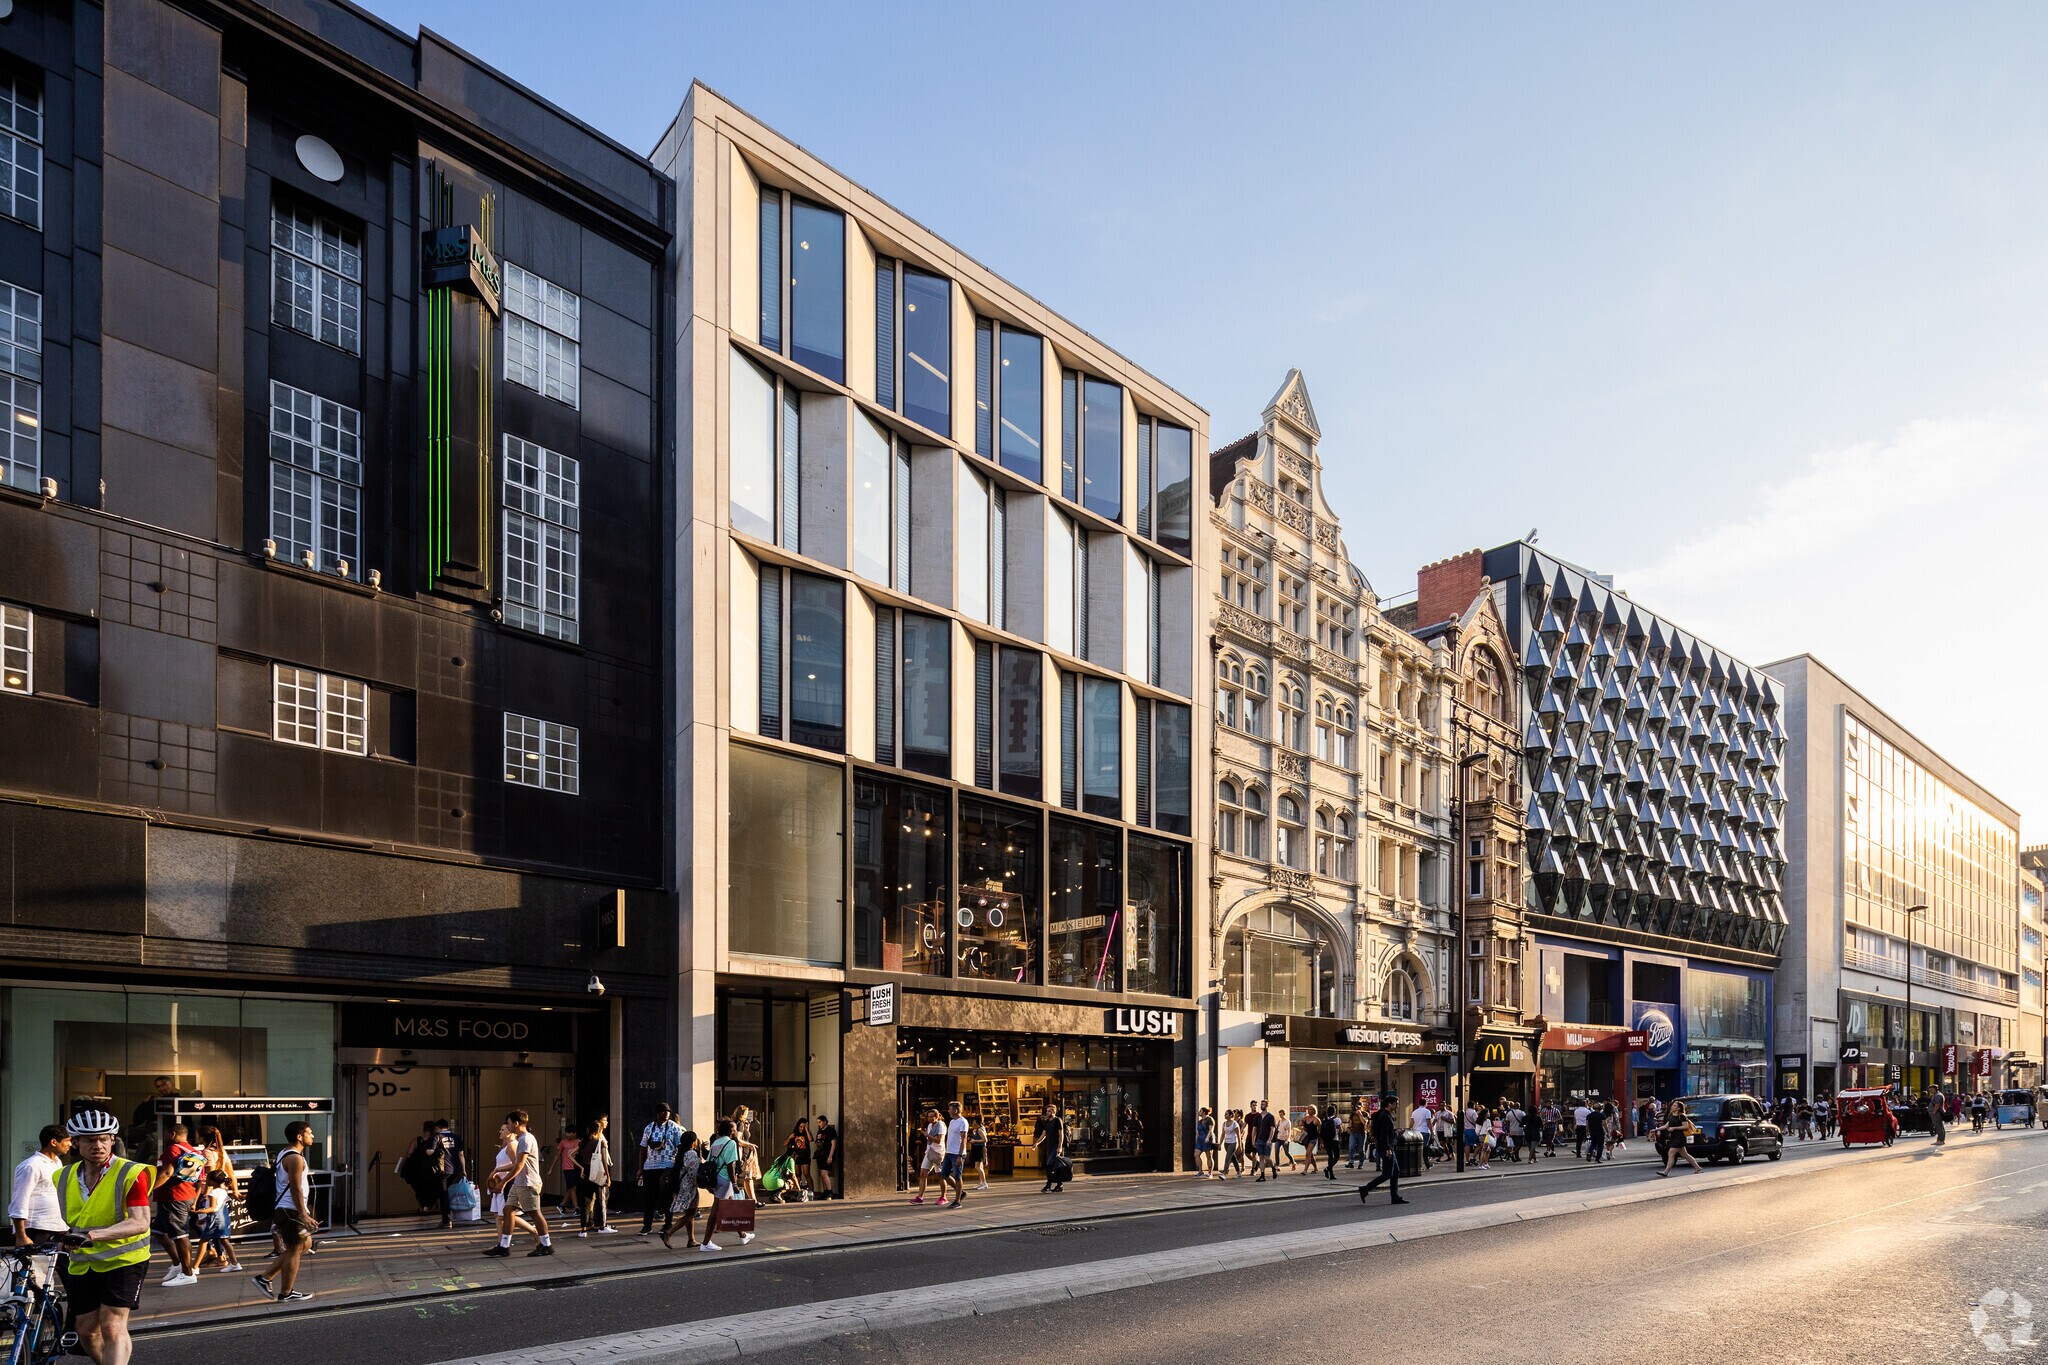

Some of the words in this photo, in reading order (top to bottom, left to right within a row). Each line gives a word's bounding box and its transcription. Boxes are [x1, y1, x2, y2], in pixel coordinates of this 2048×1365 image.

[425, 239, 468, 261] M&S
[473, 243, 500, 296] M&S
[1051, 917, 1100, 931] MAKEUP
[872, 988, 891, 999] LUSH
[872, 999, 891, 1009] FRESH
[1116, 1008, 1177, 1034] LUSH
[1846, 1004, 1860, 1034] JD
[395, 1017, 449, 1037] M&S
[459, 1020, 529, 1040] FOOD
[1346, 1025, 1379, 1043] vision
[1380, 1028, 1421, 1048] express
[1567, 1033, 1583, 1045] MUJI
[1843, 1048, 1858, 1058] JD
[731, 1054, 762, 1072] 175
[1420, 1079, 1437, 1090] £10
[1421, 1089, 1436, 1097] eye
